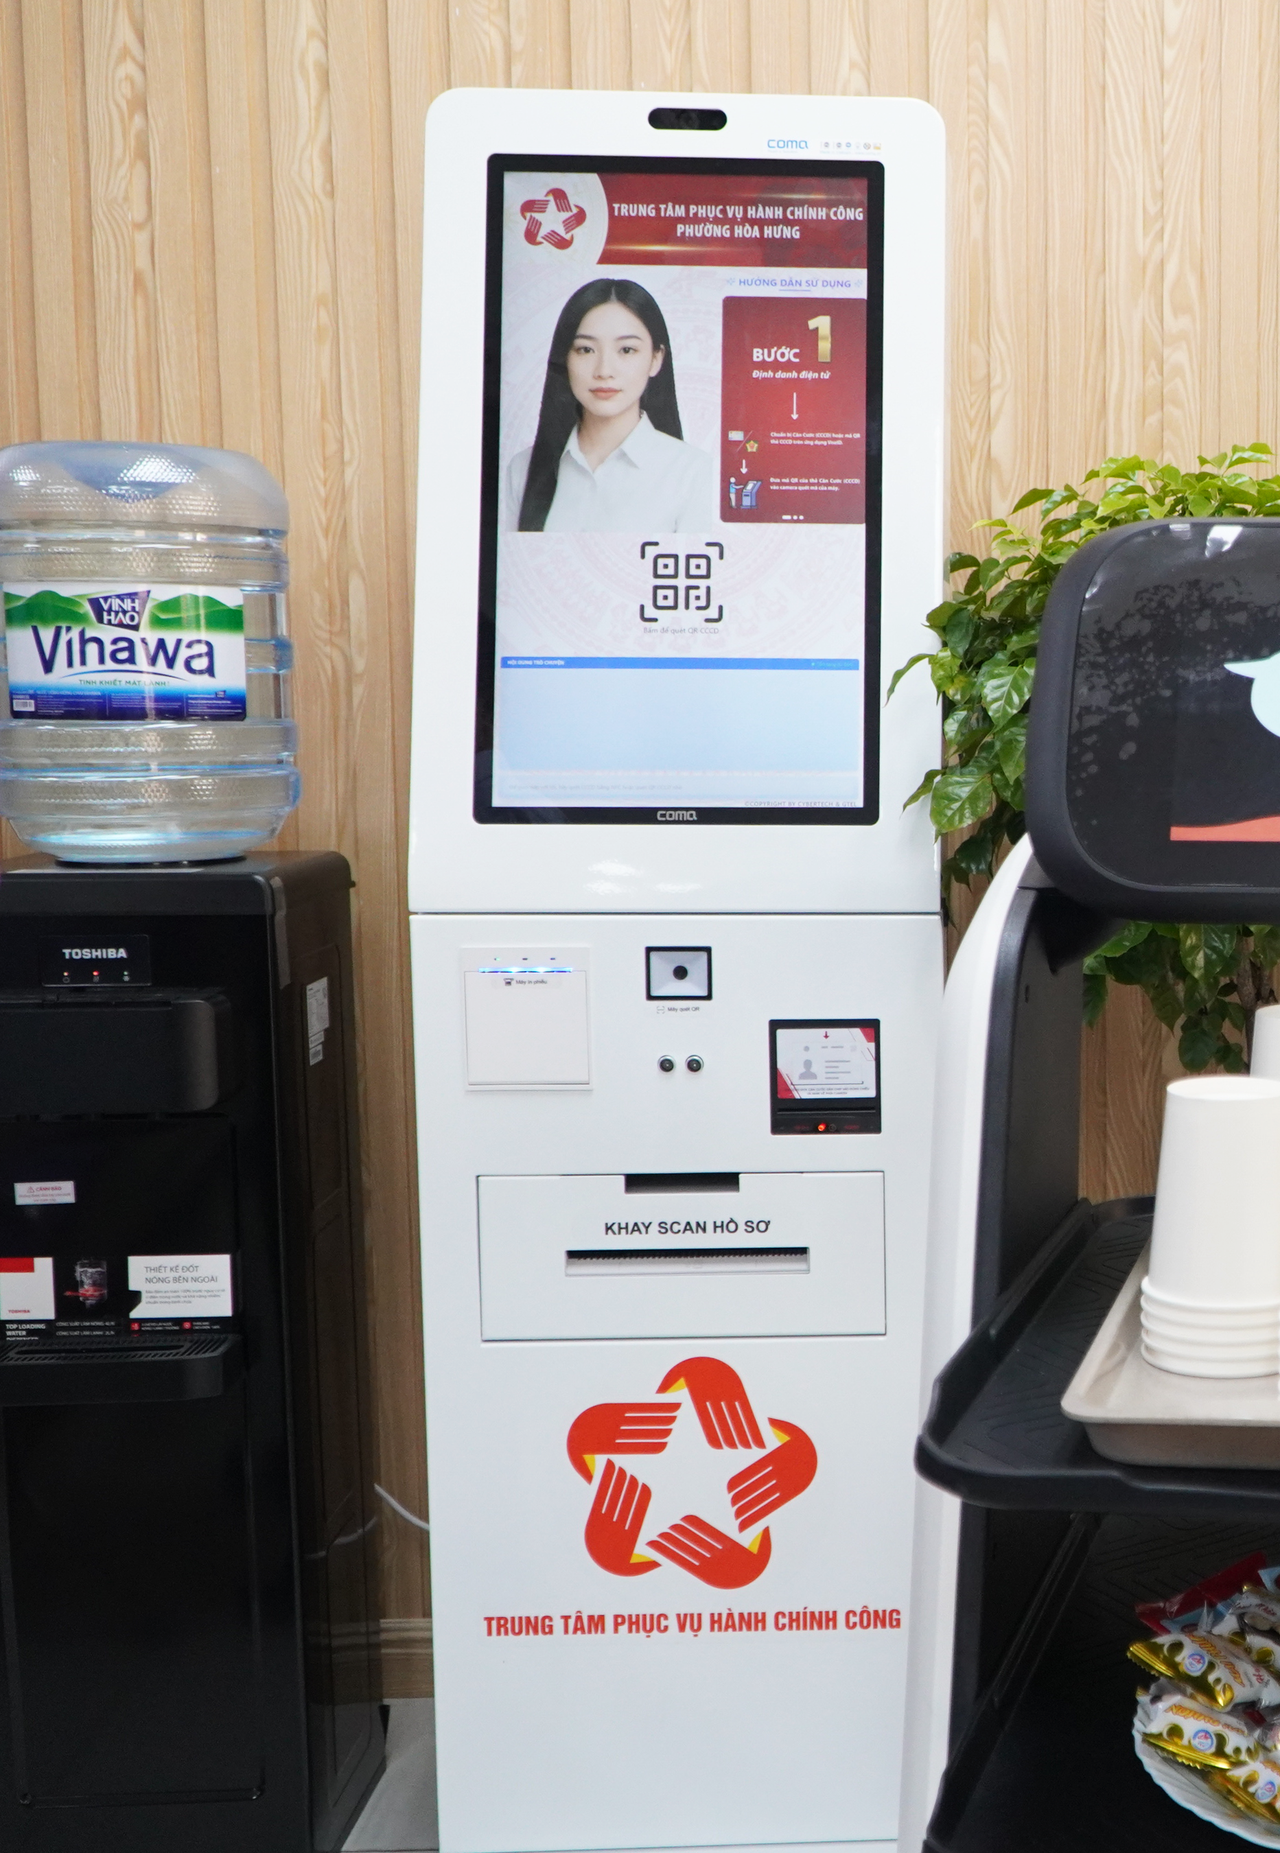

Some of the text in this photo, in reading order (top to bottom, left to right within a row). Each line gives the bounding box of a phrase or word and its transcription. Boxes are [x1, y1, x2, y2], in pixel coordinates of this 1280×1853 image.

[613, 203, 863, 222] TRUNG TÂM PHỤC VỤ HÀNH CHÍNH CÔNG
[676, 223, 800, 239] PHƯỜNG HÒA HƯNG
[739, 277, 851, 290] HƯỚNG DẪN SỬ DỤNG
[807, 315, 831, 363] 1
[753, 346, 800, 362] BƯỚC
[752, 370, 831, 380] Định danh điện tử
[670, 627, 686, 635] quét
[31, 625, 216, 679] Vihawa
[62, 948, 127, 959] TOSHIBA
[605, 1217, 771, 1236] KHAY SCAN HỒ SƠ
[483, 1605, 901, 1639] TRUNG TÂM PHỤC VỤ HÀNH CHÍNH CÔNG
